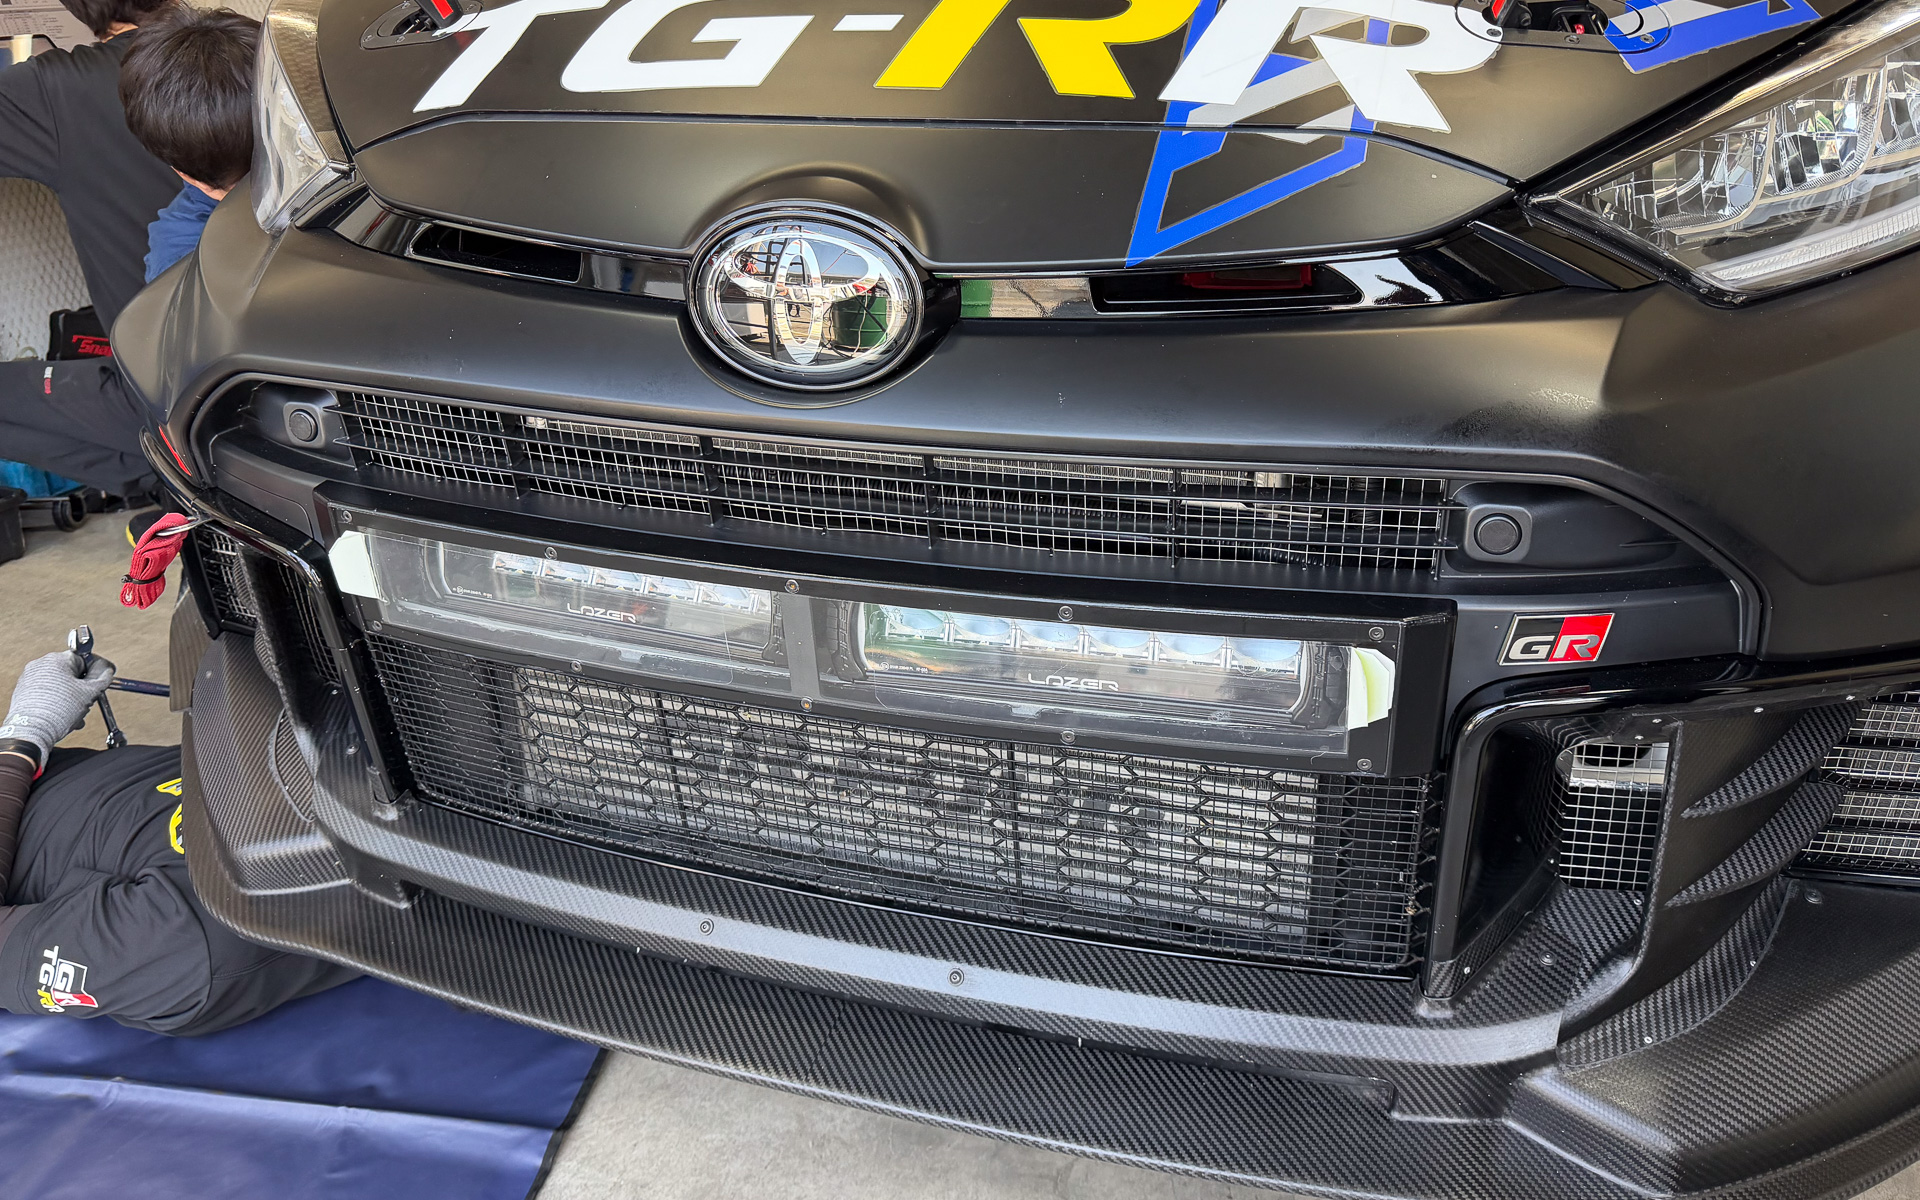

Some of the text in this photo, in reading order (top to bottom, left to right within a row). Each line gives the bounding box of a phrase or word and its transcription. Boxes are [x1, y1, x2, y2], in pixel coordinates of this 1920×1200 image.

[412, 0, 1504, 132] TG-RR
[567, 603, 636, 623] LAZER
[1508, 634, 1600, 660] GR
[1027, 673, 1119, 691] LAZER
